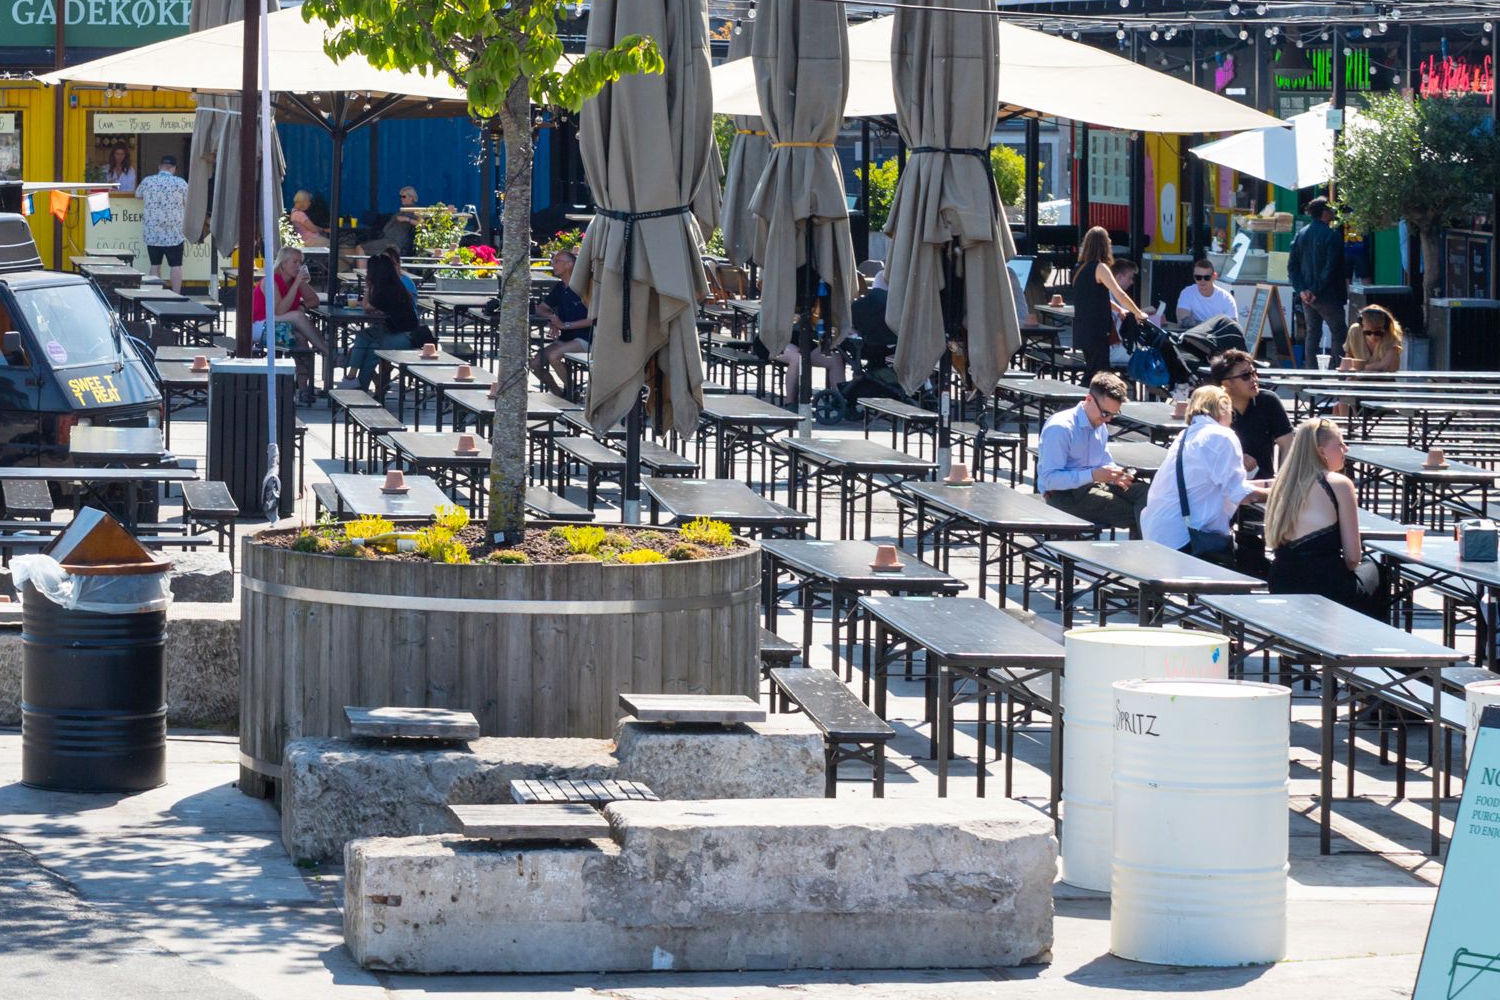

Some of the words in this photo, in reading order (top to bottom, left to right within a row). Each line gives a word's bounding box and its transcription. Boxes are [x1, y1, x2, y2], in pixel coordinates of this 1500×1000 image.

[1346, 47, 1371, 90] RILL
[1114, 698, 1160, 737] SPRITZ
[1468, 824, 1481, 835] TO
